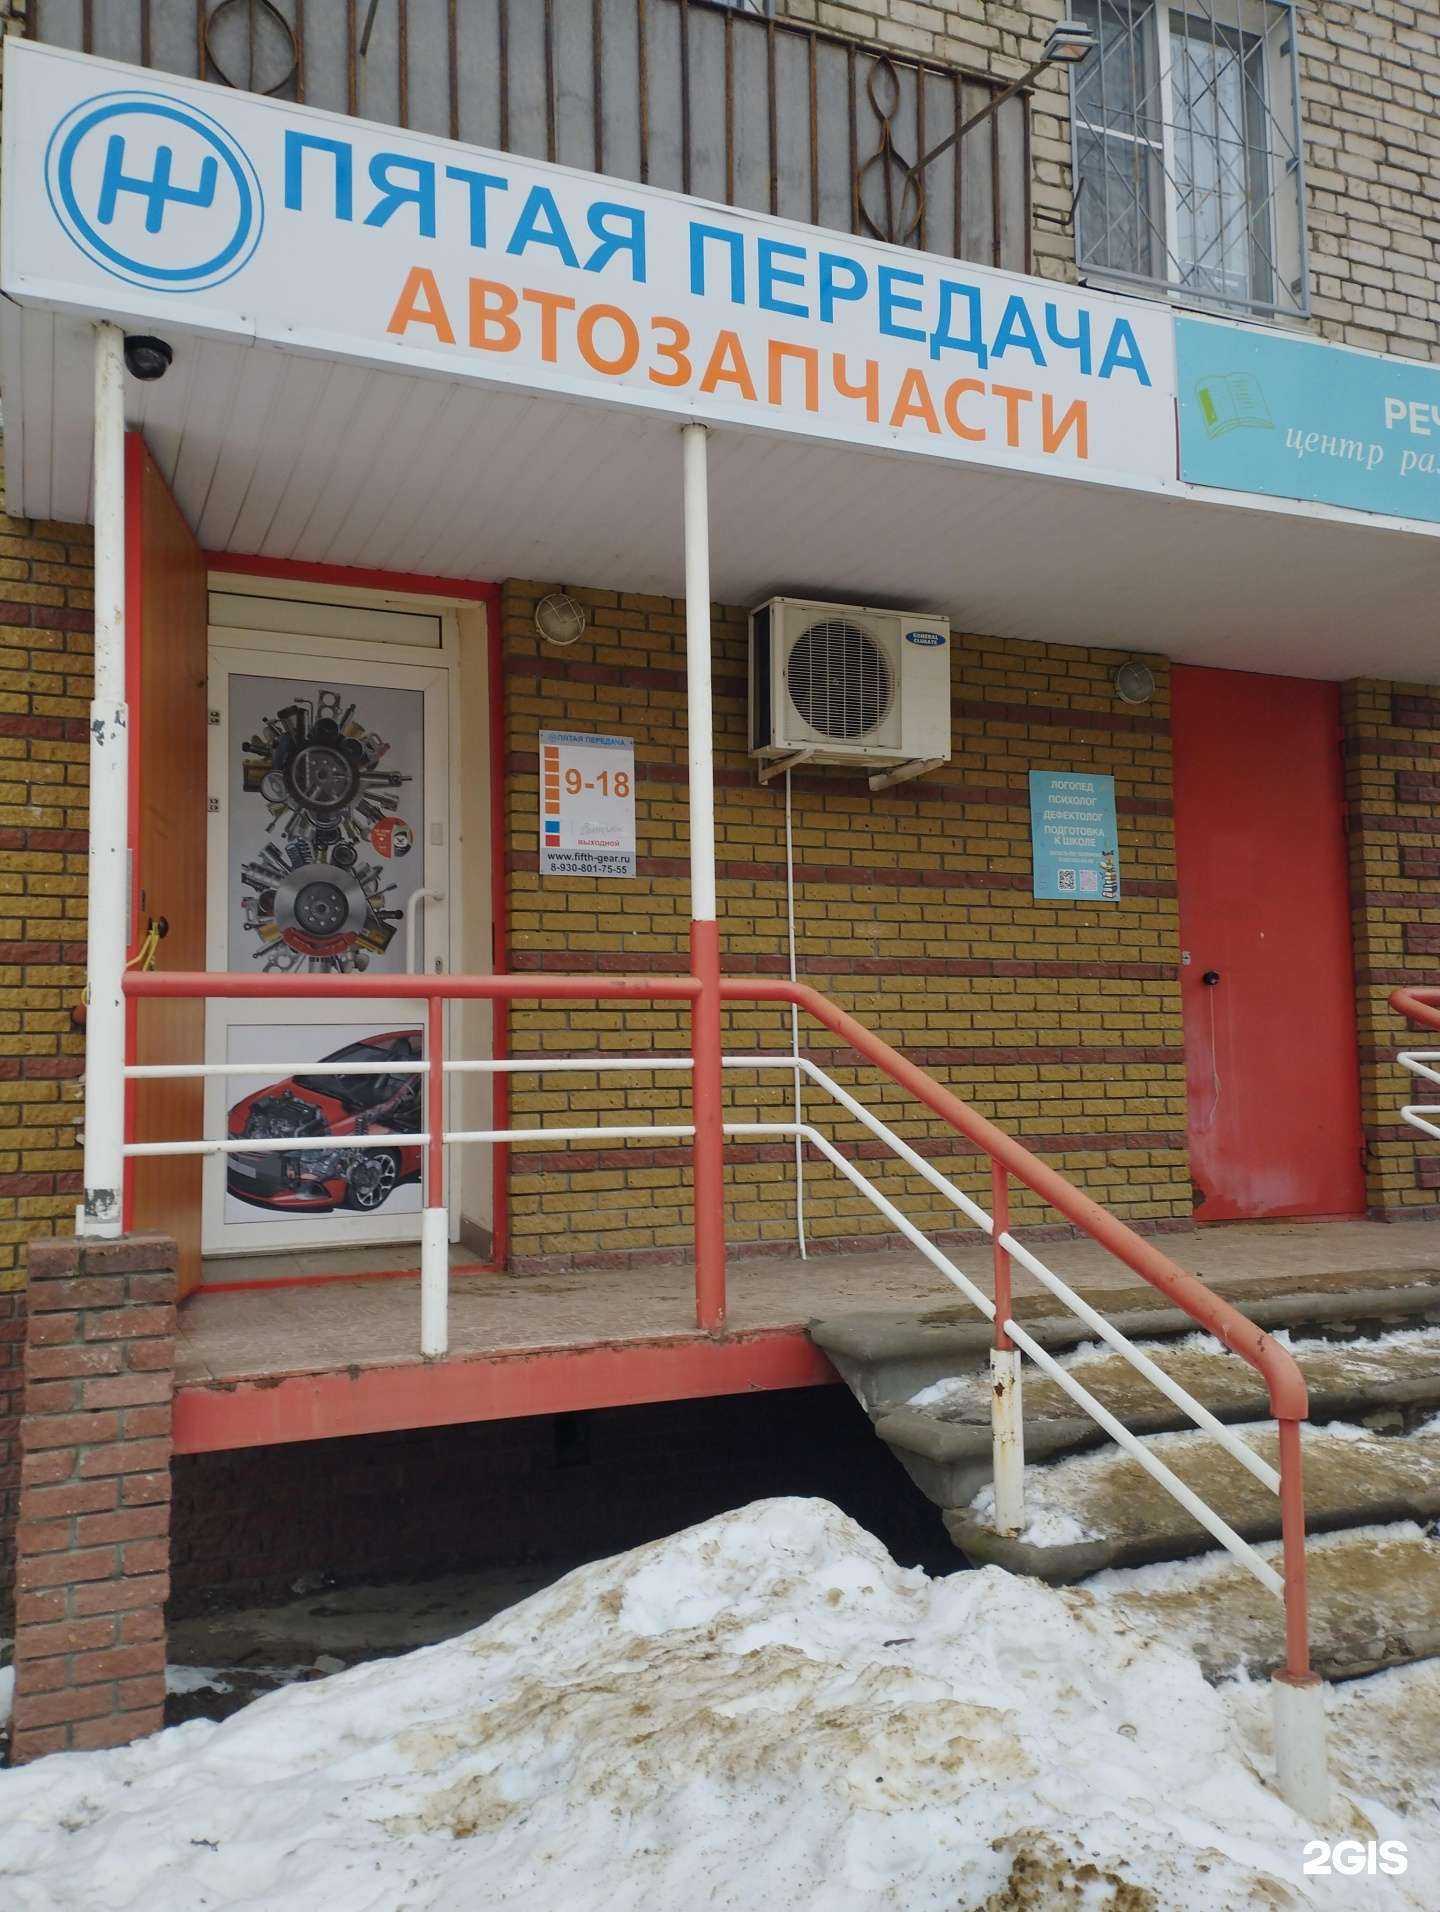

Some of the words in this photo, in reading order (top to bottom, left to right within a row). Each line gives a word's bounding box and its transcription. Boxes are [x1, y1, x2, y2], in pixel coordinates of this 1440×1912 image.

[284, 129, 647, 283] ПЯТАЯ
[688, 220, 1152, 388] ПЕРЕДАЧА
[386, 265, 1089, 460] АВТОЗАПЧАСТИ
[1285, 428, 1385, 471] центр
[1400, 450, 1440, 477] ра
[558, 734, 585, 744] ПЯТАЯ
[586, 736, 625, 746] ПЕРЕДАЧА
[564, 768, 630, 798] 9-18
[1050, 781, 1094, 793] ЛОГОПЕД
[1048, 795, 1097, 806] ПСИХОЛОГ
[1043, 810, 1104, 822] ДЕФЕКТОЛОГ
[1044, 825, 1104, 837] ПОДГОТОВКА
[1063, 837, 1097, 847] ШКОЛЕ
[547, 852, 630, 863] www.fifth-gear.ru
[550, 863, 627, 874] 8-930-801-75-55
